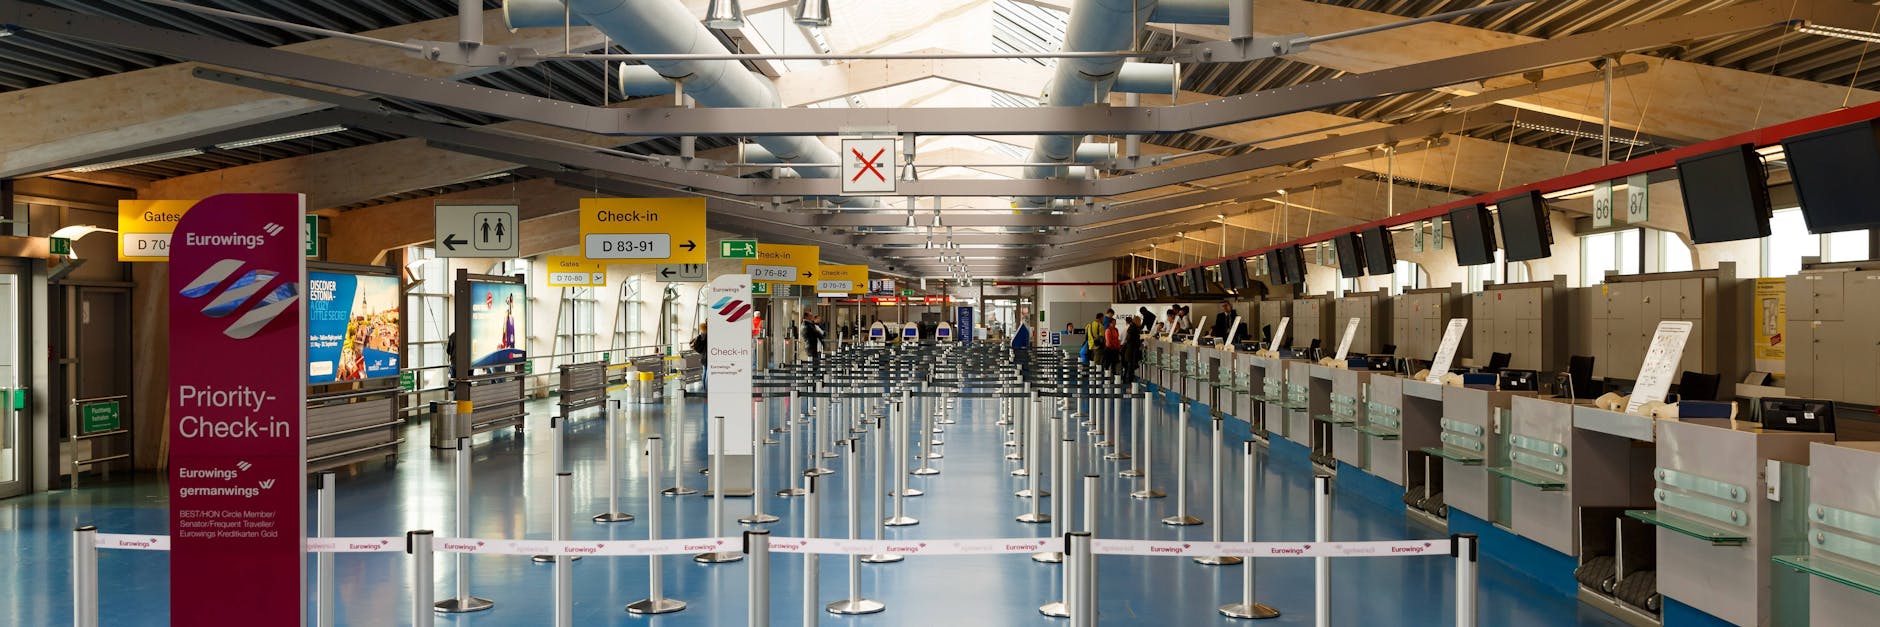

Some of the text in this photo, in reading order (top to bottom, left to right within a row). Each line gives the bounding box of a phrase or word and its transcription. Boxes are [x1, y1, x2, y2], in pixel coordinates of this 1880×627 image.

[1596, 198, 1608, 220] 86
[1630, 192, 1644, 215] 87
[144, 211, 180, 222] Gates
[597, 210, 658, 222] Check-in
[138, 240, 147, 250] D
[186, 232, 265, 250] Eurowings
[602, 240, 654, 252] D 83-91
[764, 269, 788, 278] 76-82
[310, 280, 336, 291] DISCOVER
[710, 347, 748, 356] Check-in
[180, 385, 276, 412] Priority-
[179, 416, 290, 438] Check-in
[179, 468, 238, 480] Eurowings
[180, 486, 260, 498] germanwings
[180, 510, 220, 518] BEST/HON
[221, 510, 242, 518] Circle
[180, 530, 216, 540] Eurowings
[260, 530, 278, 538] Gold
[119, 540, 150, 548] Eurowings
[444, 542, 476, 551] Eurowings
